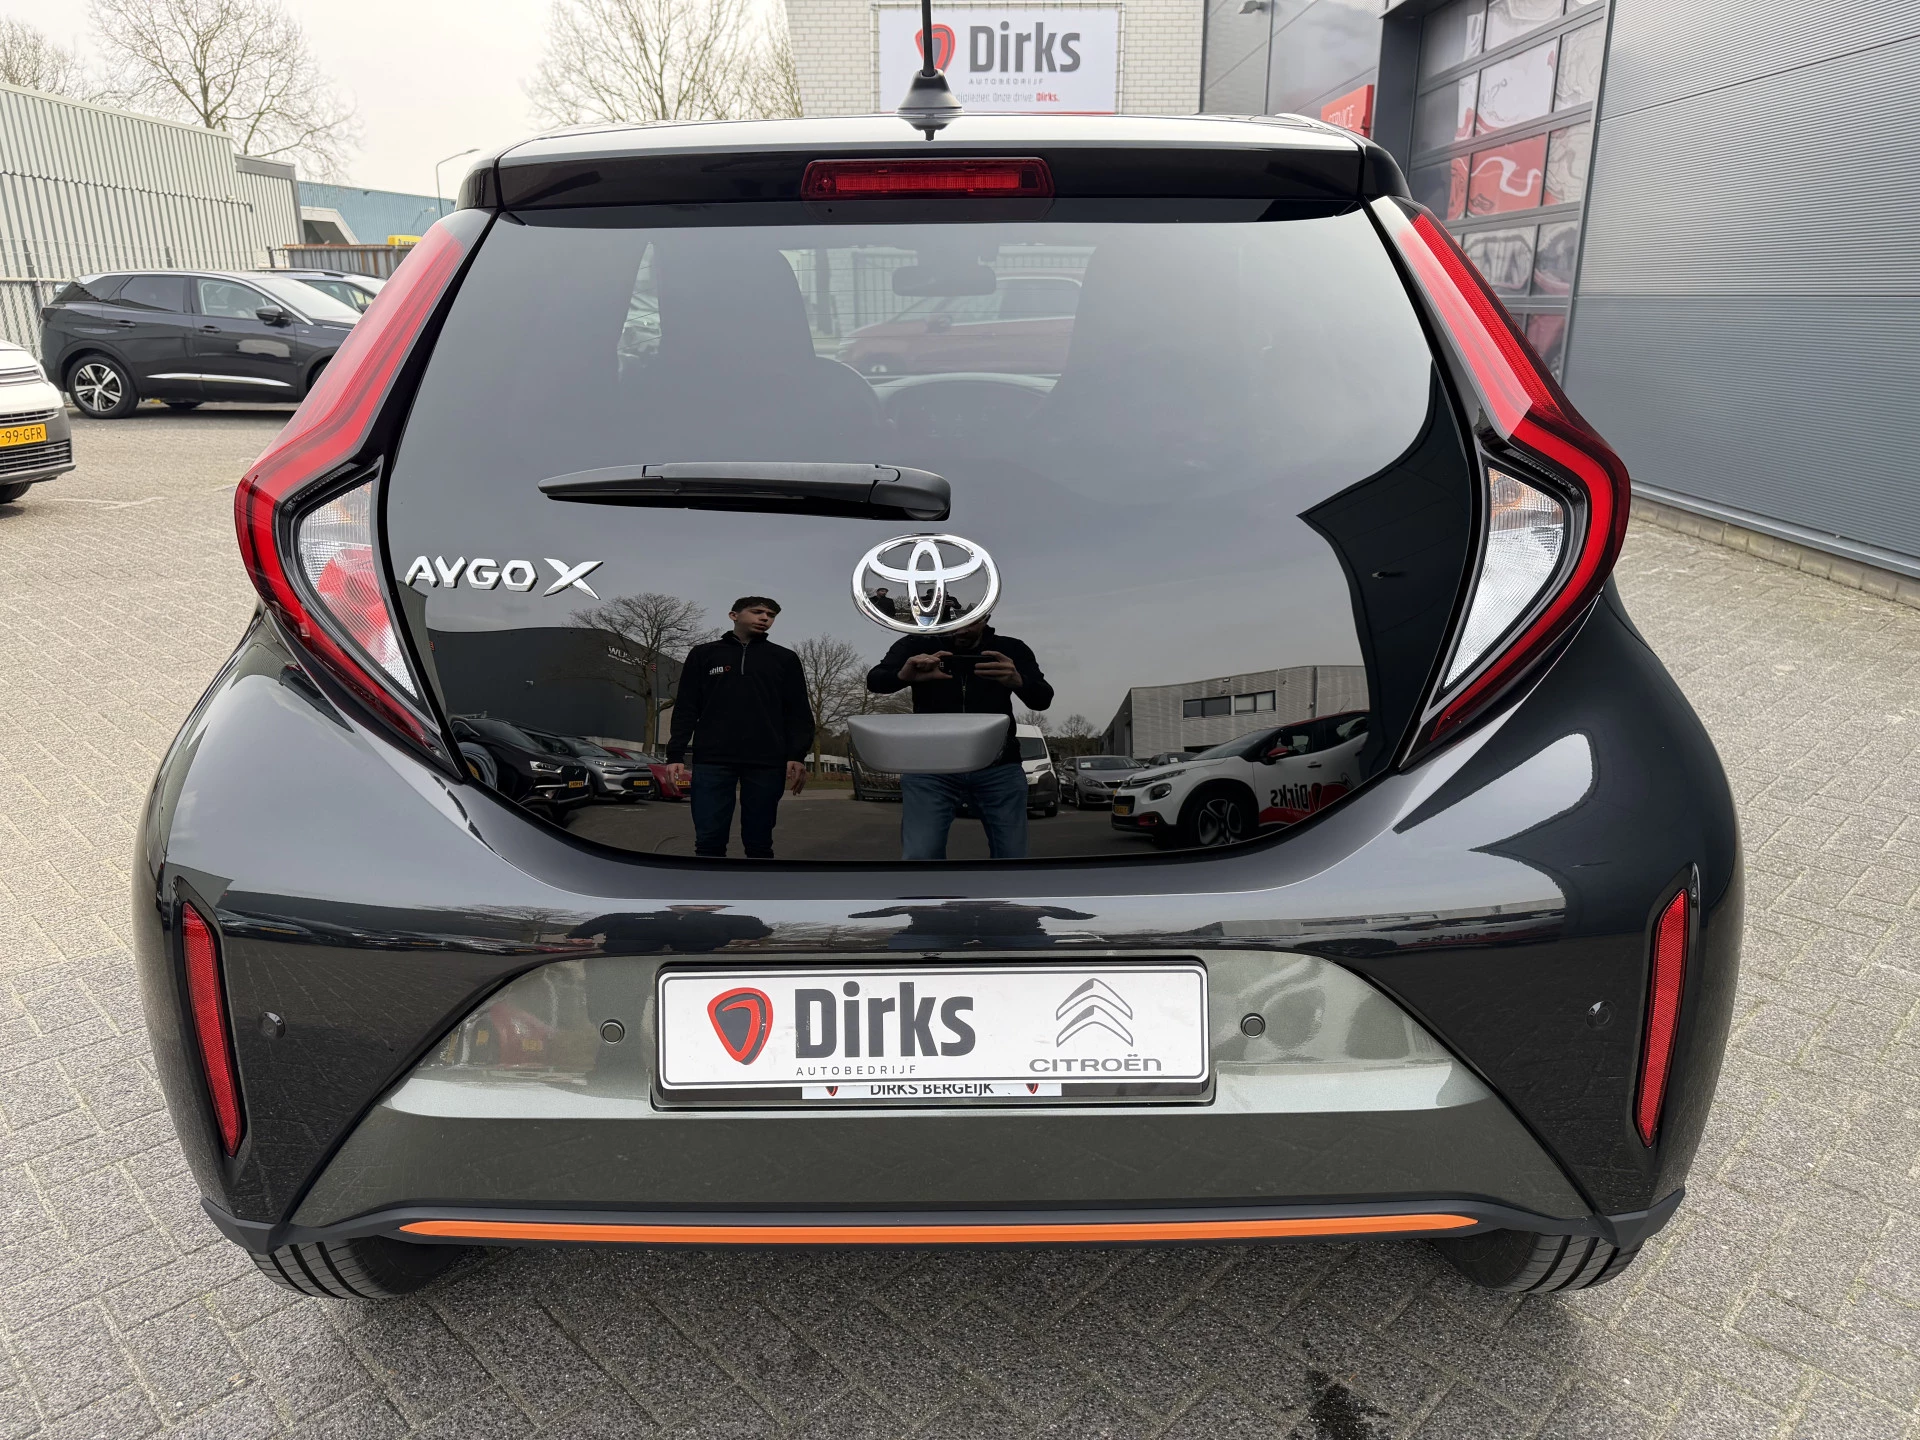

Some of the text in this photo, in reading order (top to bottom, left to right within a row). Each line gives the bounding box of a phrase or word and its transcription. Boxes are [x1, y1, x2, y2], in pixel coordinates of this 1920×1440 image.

[969, 21, 1081, 73] Dirks
[404, 555, 604, 600] AYGO X
[794, 981, 976, 1059] Dirks
[796, 1064, 917, 1077] AUTOBEDRIJF
[870, 1084, 918, 1096] DIRKS
